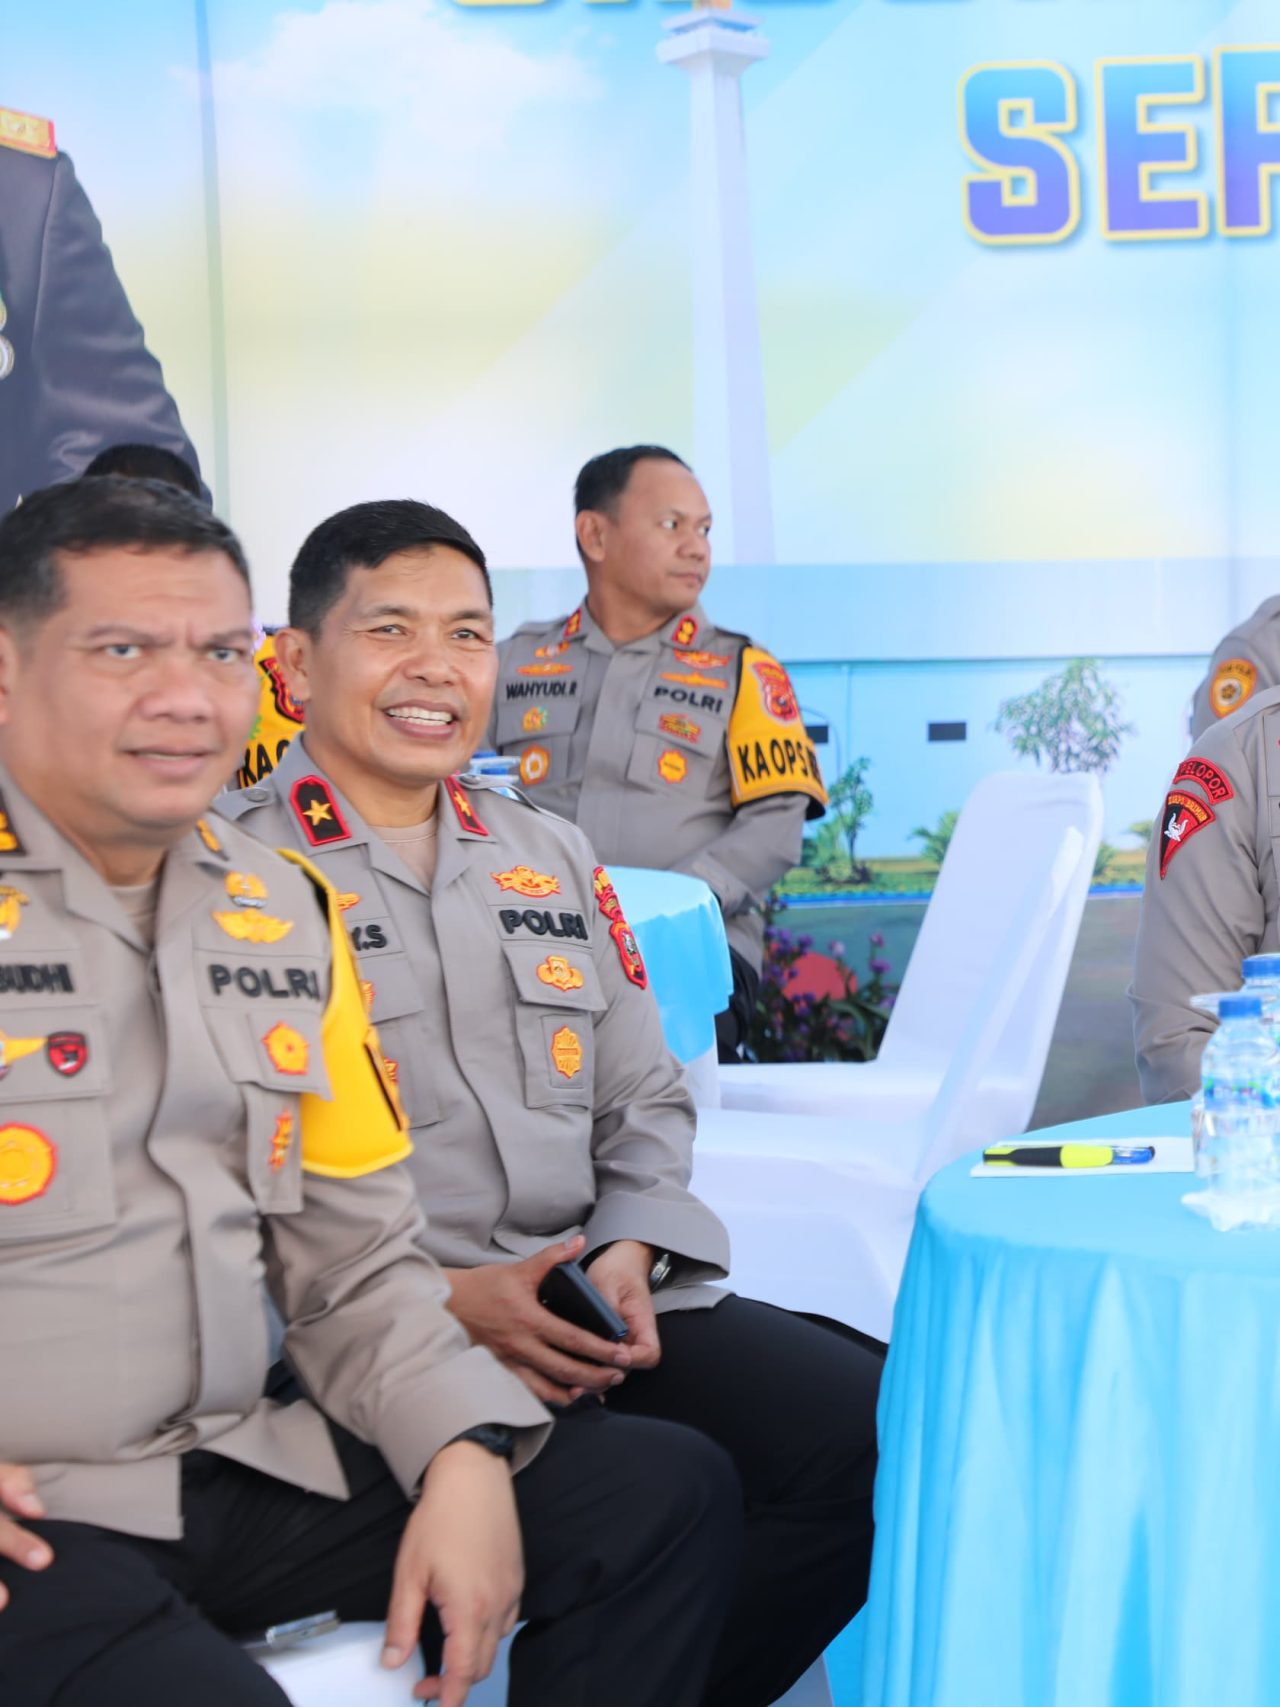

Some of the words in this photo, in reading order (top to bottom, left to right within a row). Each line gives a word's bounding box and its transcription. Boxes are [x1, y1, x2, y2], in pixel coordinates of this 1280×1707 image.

[654, 686, 724, 714] POLRI
[499, 908, 589, 941] POLRI
[207, 963, 321, 1001] POLRI
